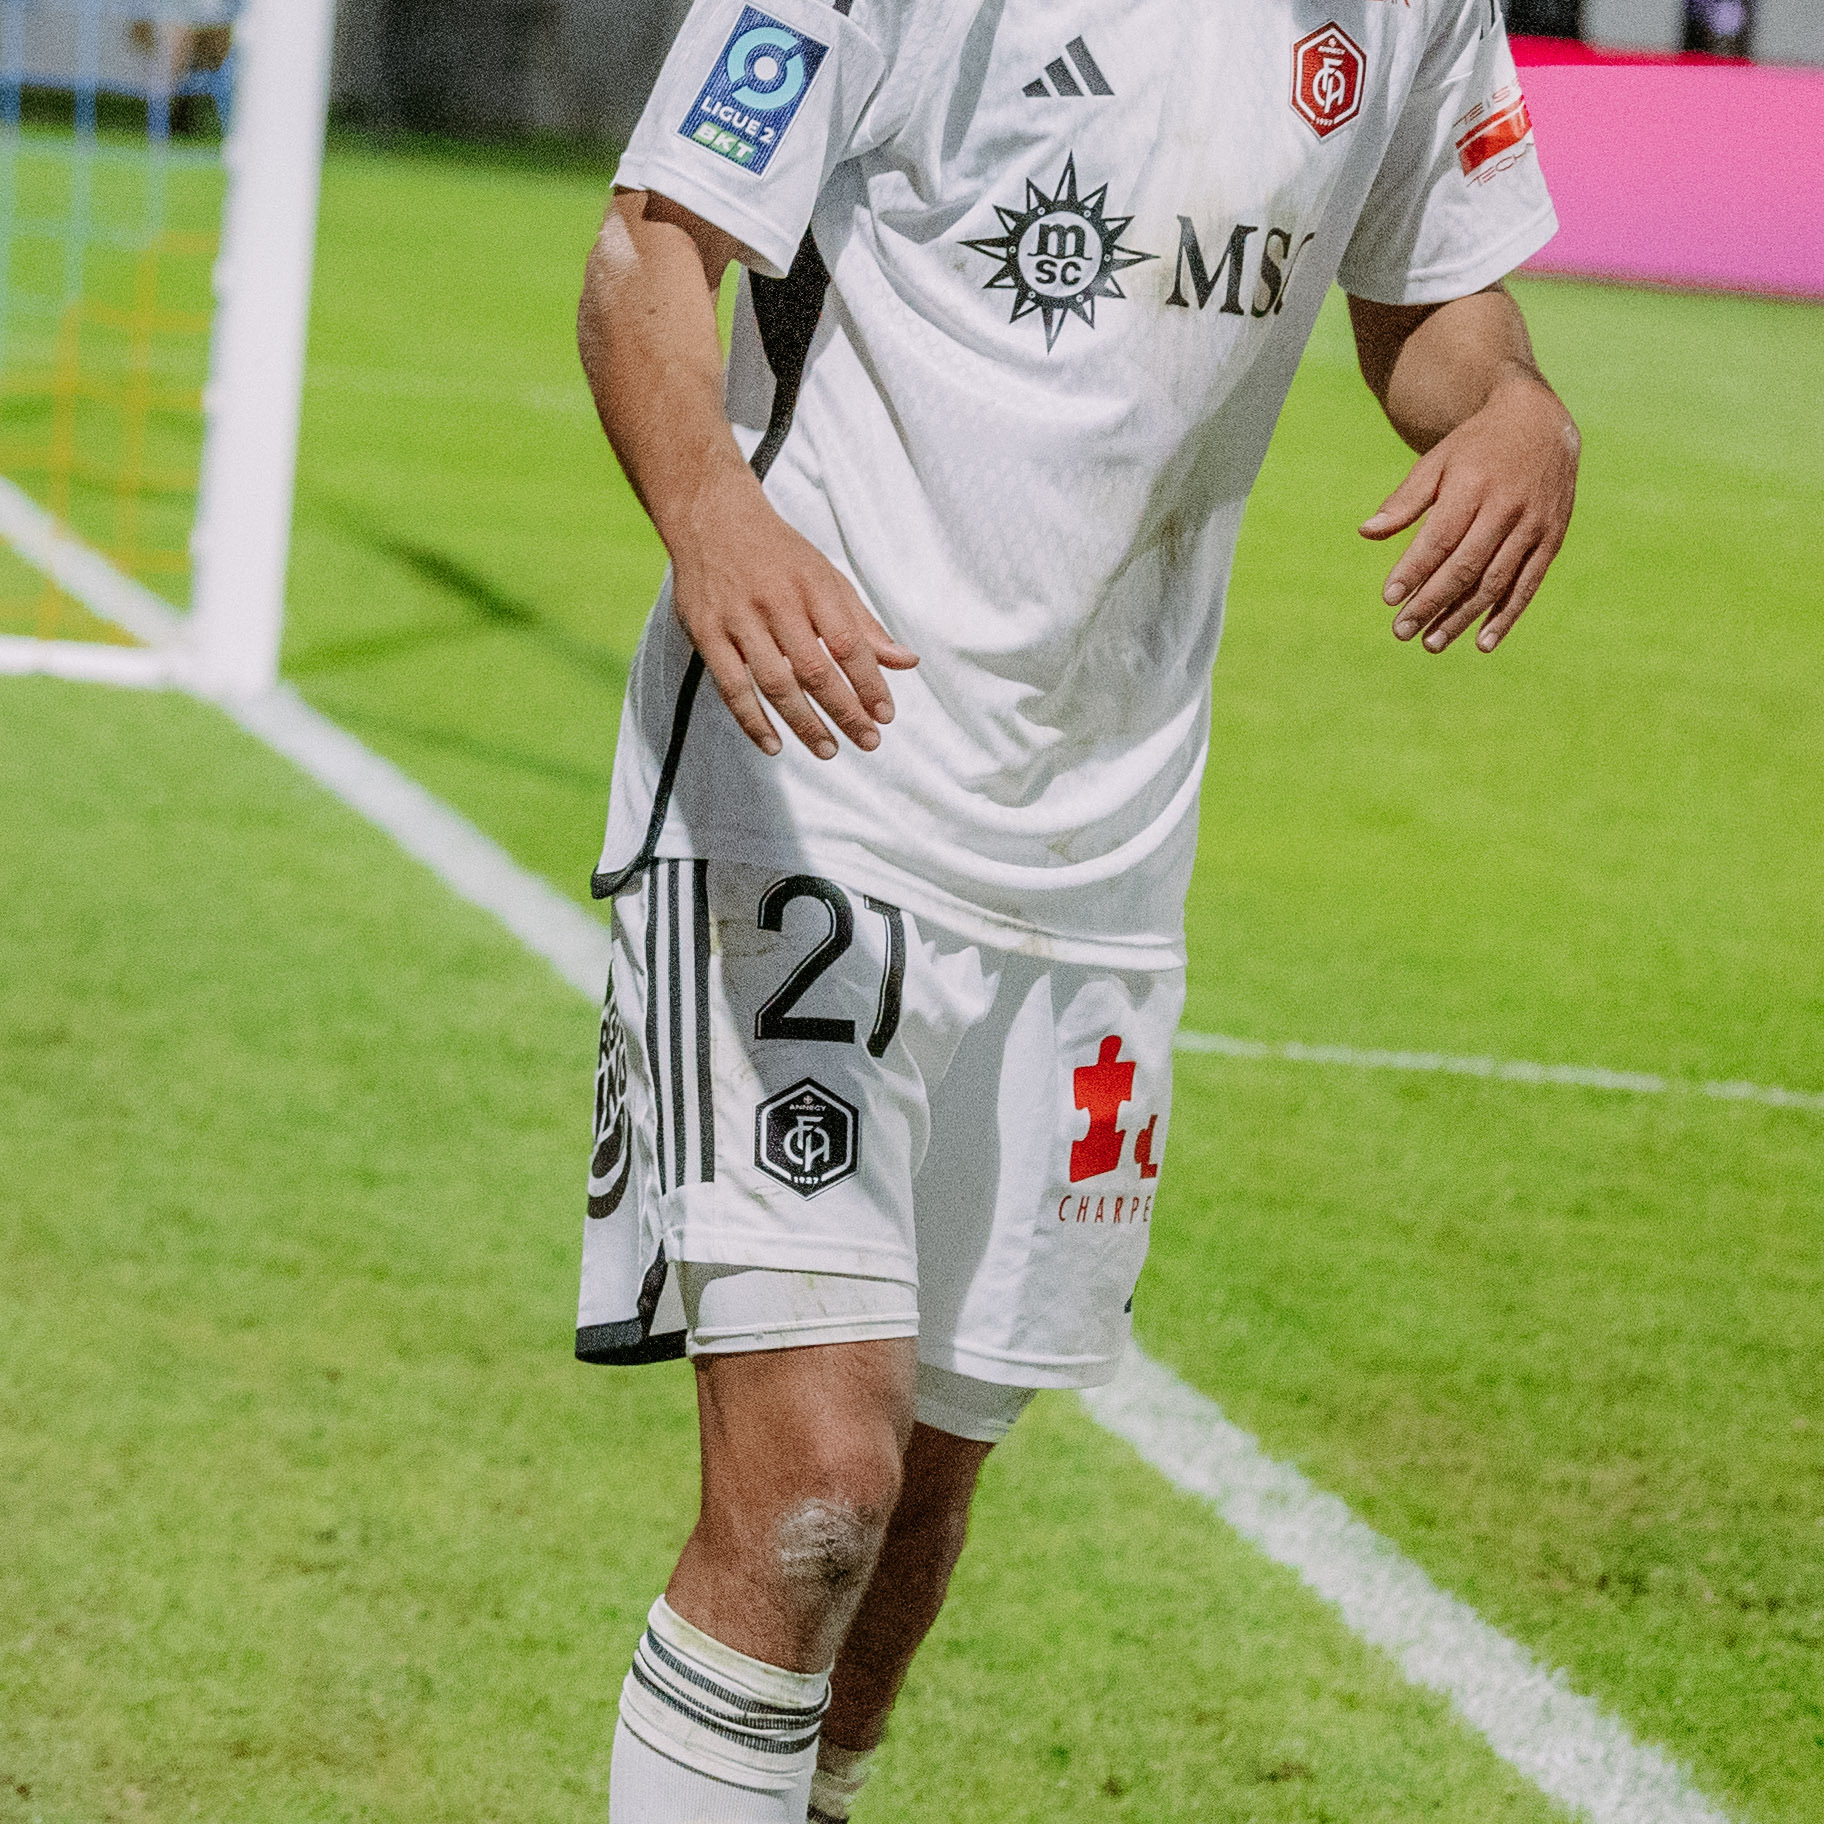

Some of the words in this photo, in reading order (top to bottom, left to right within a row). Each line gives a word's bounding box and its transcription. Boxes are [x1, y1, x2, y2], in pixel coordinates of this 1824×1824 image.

[696, 124, 755, 158] BKT
[700, 96, 762, 136] LIGUE
[759, 127, 775, 144] 2
[753, 874, 907, 1057] 21
